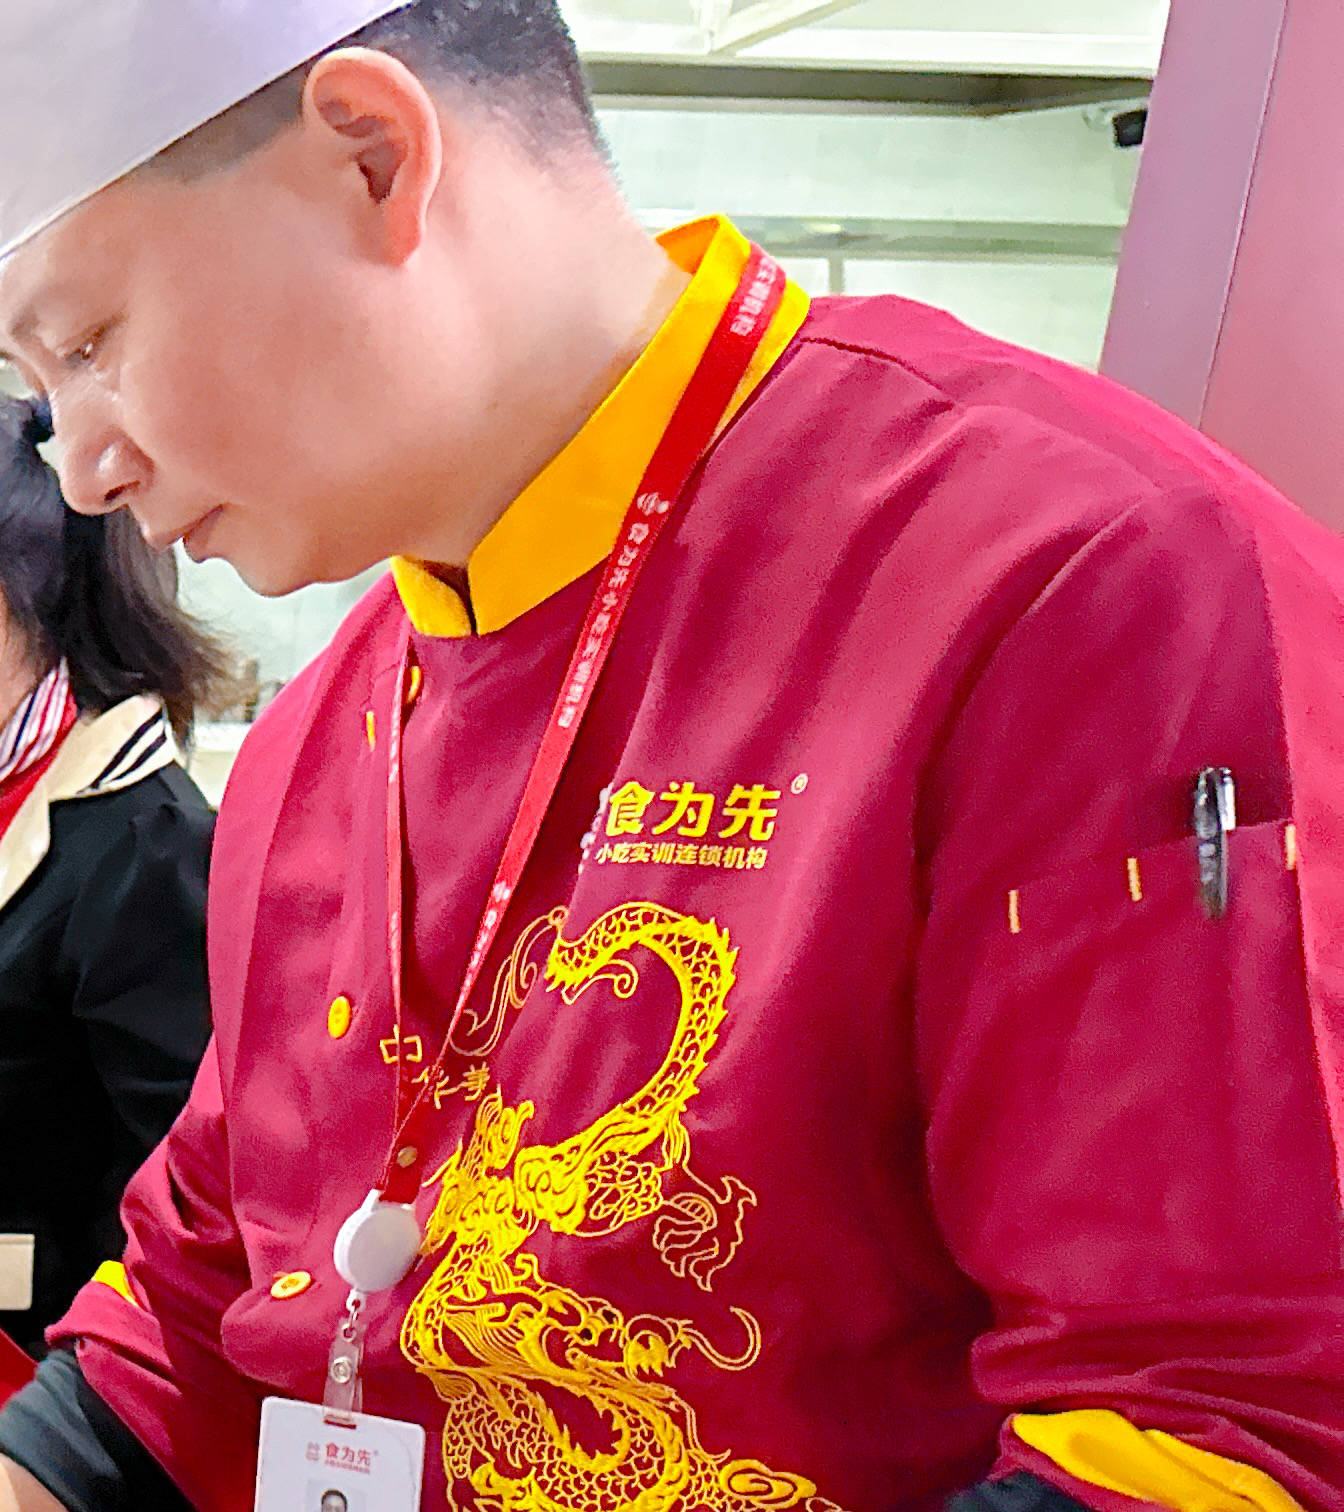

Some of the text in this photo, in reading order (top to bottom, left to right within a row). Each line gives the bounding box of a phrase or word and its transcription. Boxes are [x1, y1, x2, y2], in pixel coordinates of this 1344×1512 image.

[605, 780, 782, 842] 食为先
[594, 841, 769, 871] 小吃实训连锁机构
[325, 1442, 372, 1467] 食为先
